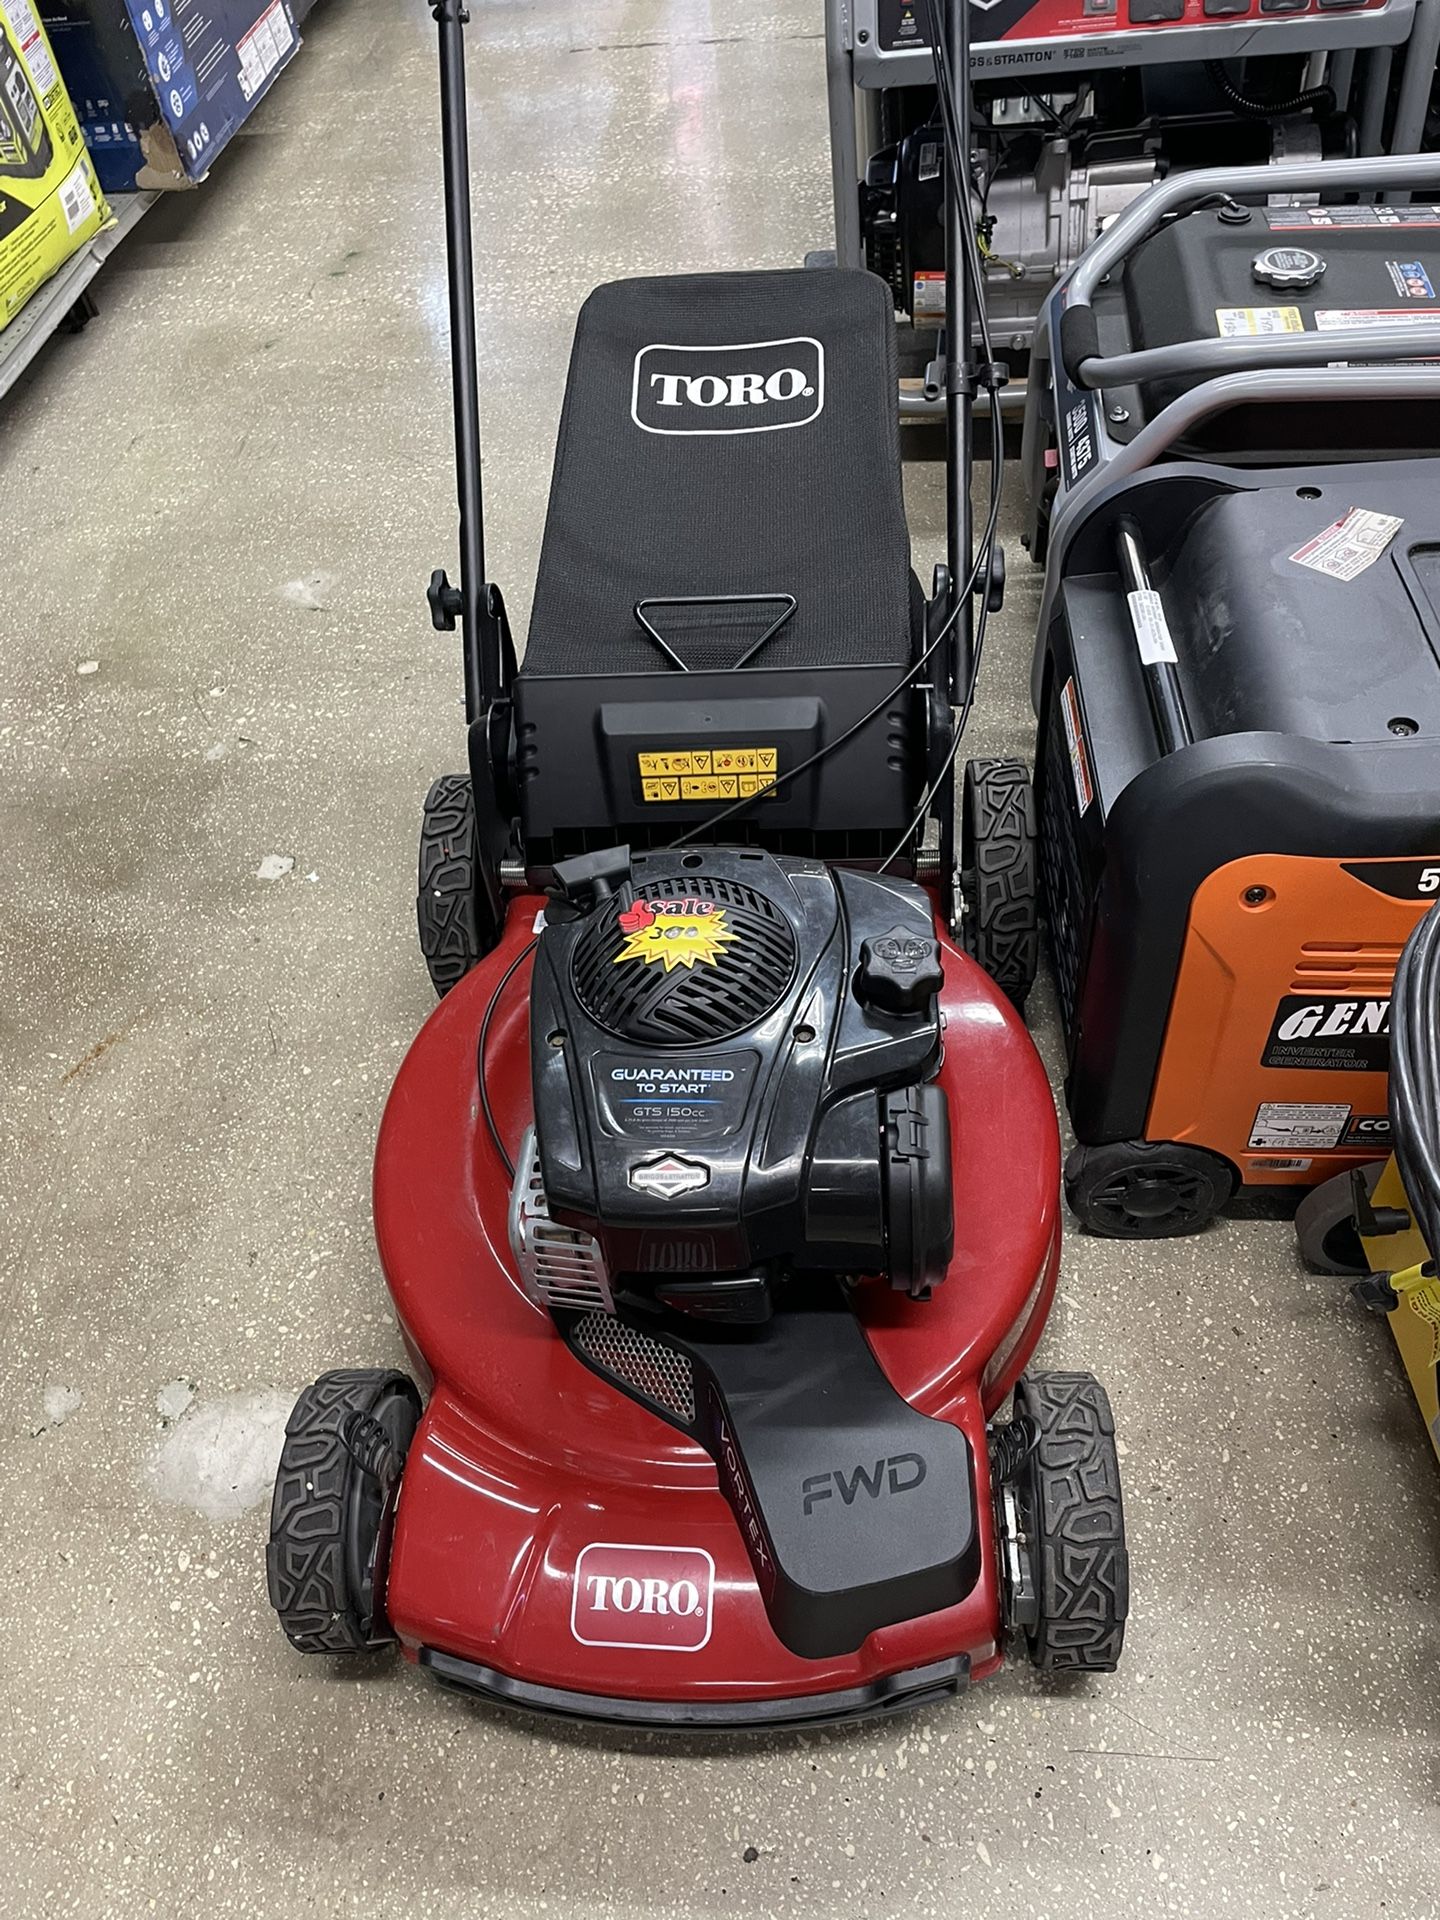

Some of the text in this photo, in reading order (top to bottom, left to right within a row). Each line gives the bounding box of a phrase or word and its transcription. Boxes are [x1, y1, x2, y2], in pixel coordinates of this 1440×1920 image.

[650, 368, 808, 407] TORO
[1075, 434, 1093, 471] 4375
[647, 898, 713, 917] sale
[1277, 1001, 1391, 1041] GEN
[1268, 1056, 1369, 1069] GENERATOR
[1271, 1045, 1356, 1058] INVERTER
[611, 1068, 735, 1081] GUARANTEED
[636, 1083, 706, 1094] TO START
[633, 1106, 662, 1117] GTS
[720, 1419, 769, 1568] VORTEX
[802, 1453, 928, 1515] FWD
[586, 1575, 699, 1616] TORO
